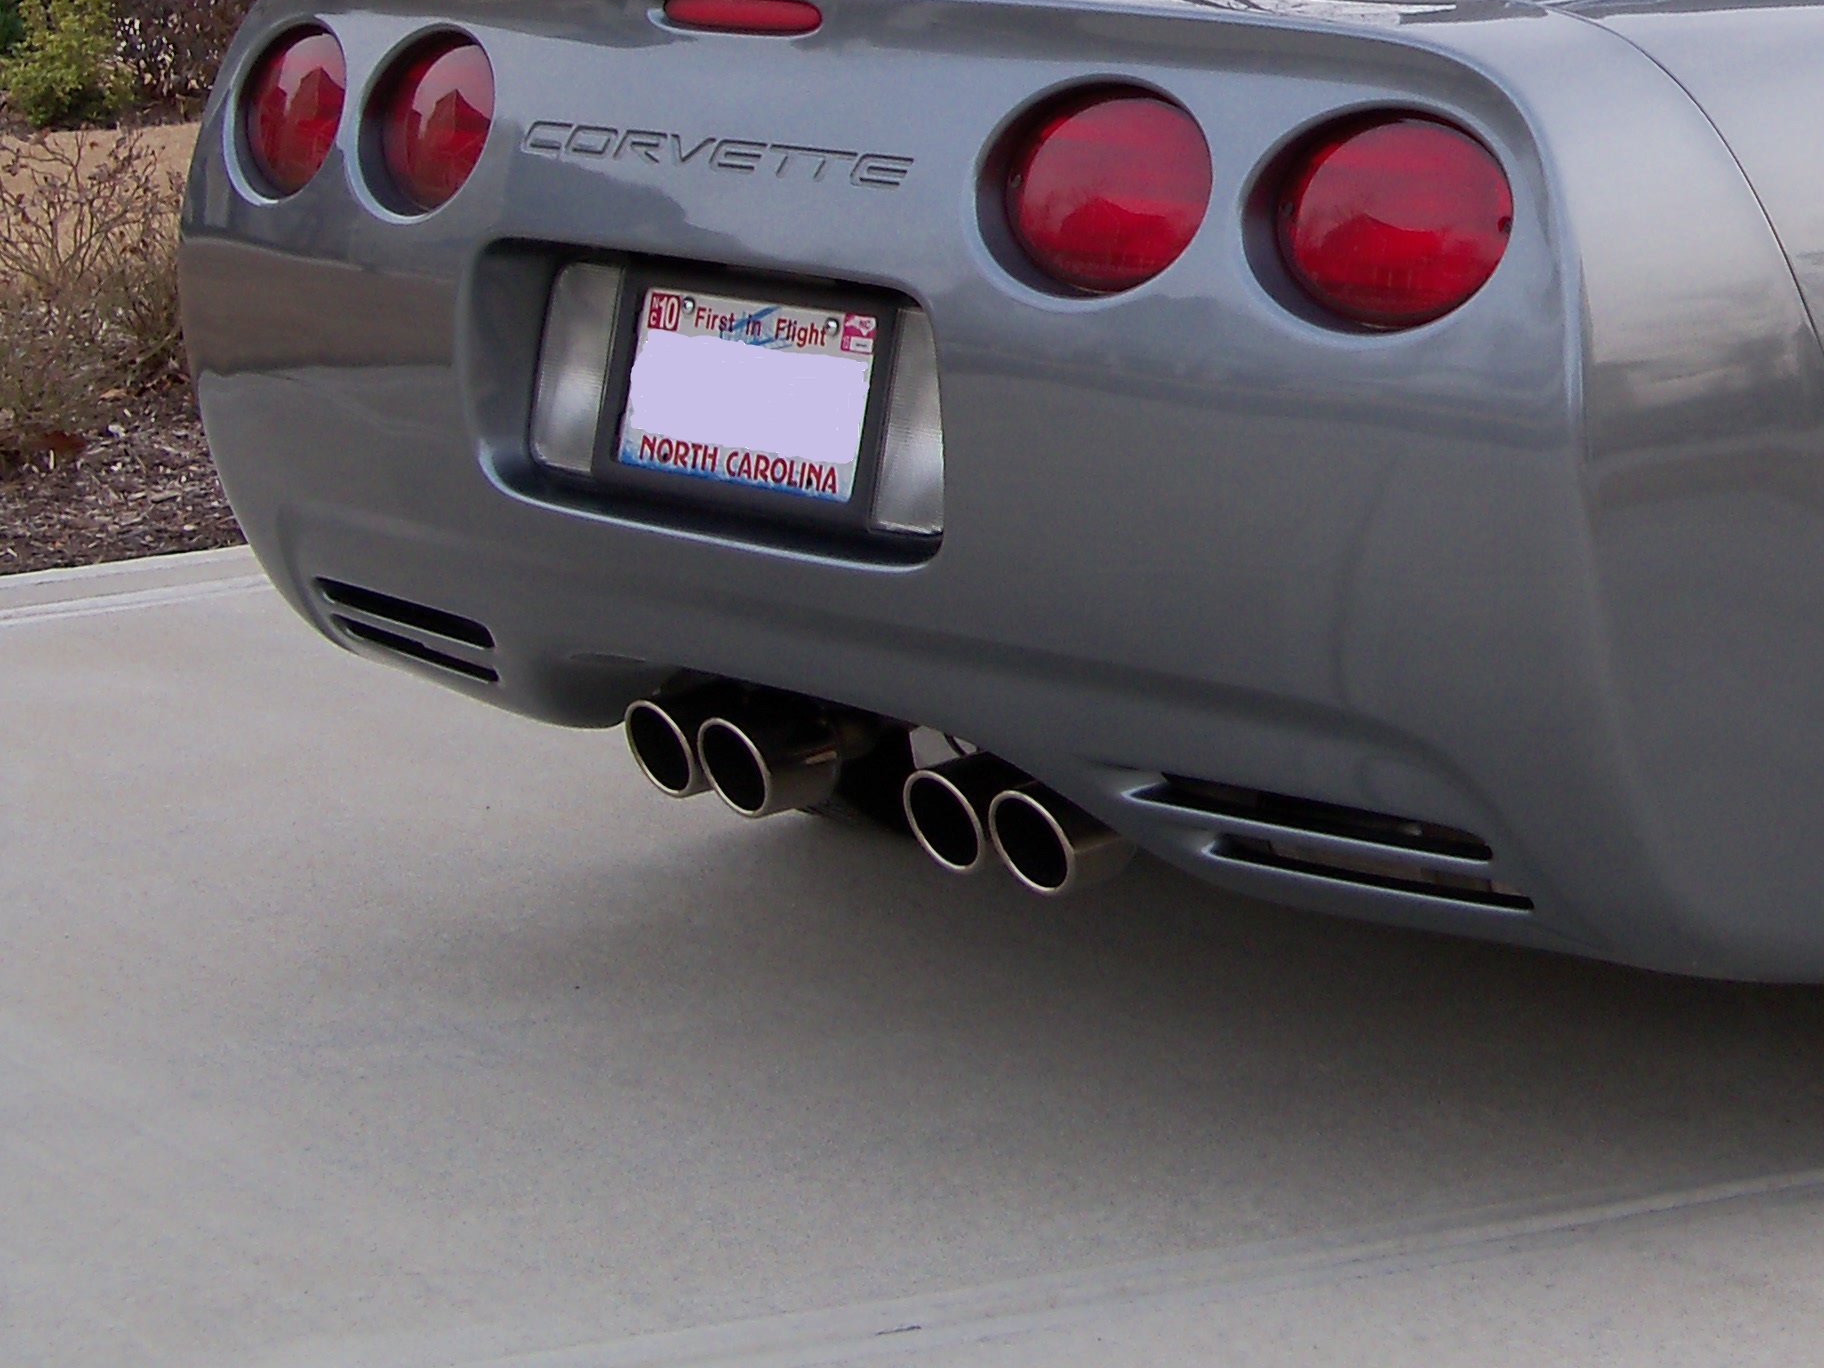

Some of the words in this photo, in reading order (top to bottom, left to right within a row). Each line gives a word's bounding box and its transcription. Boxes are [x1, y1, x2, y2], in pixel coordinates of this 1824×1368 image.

[521, 120, 914, 189] CORVETTE
[659, 296, 678, 329] 10
[694, 307, 735, 333] First
[745, 314, 761, 336] in
[775, 317, 827, 347] Flight
[639, 434, 719, 472] NORTH
[725, 451, 837, 494] CAROLINA
